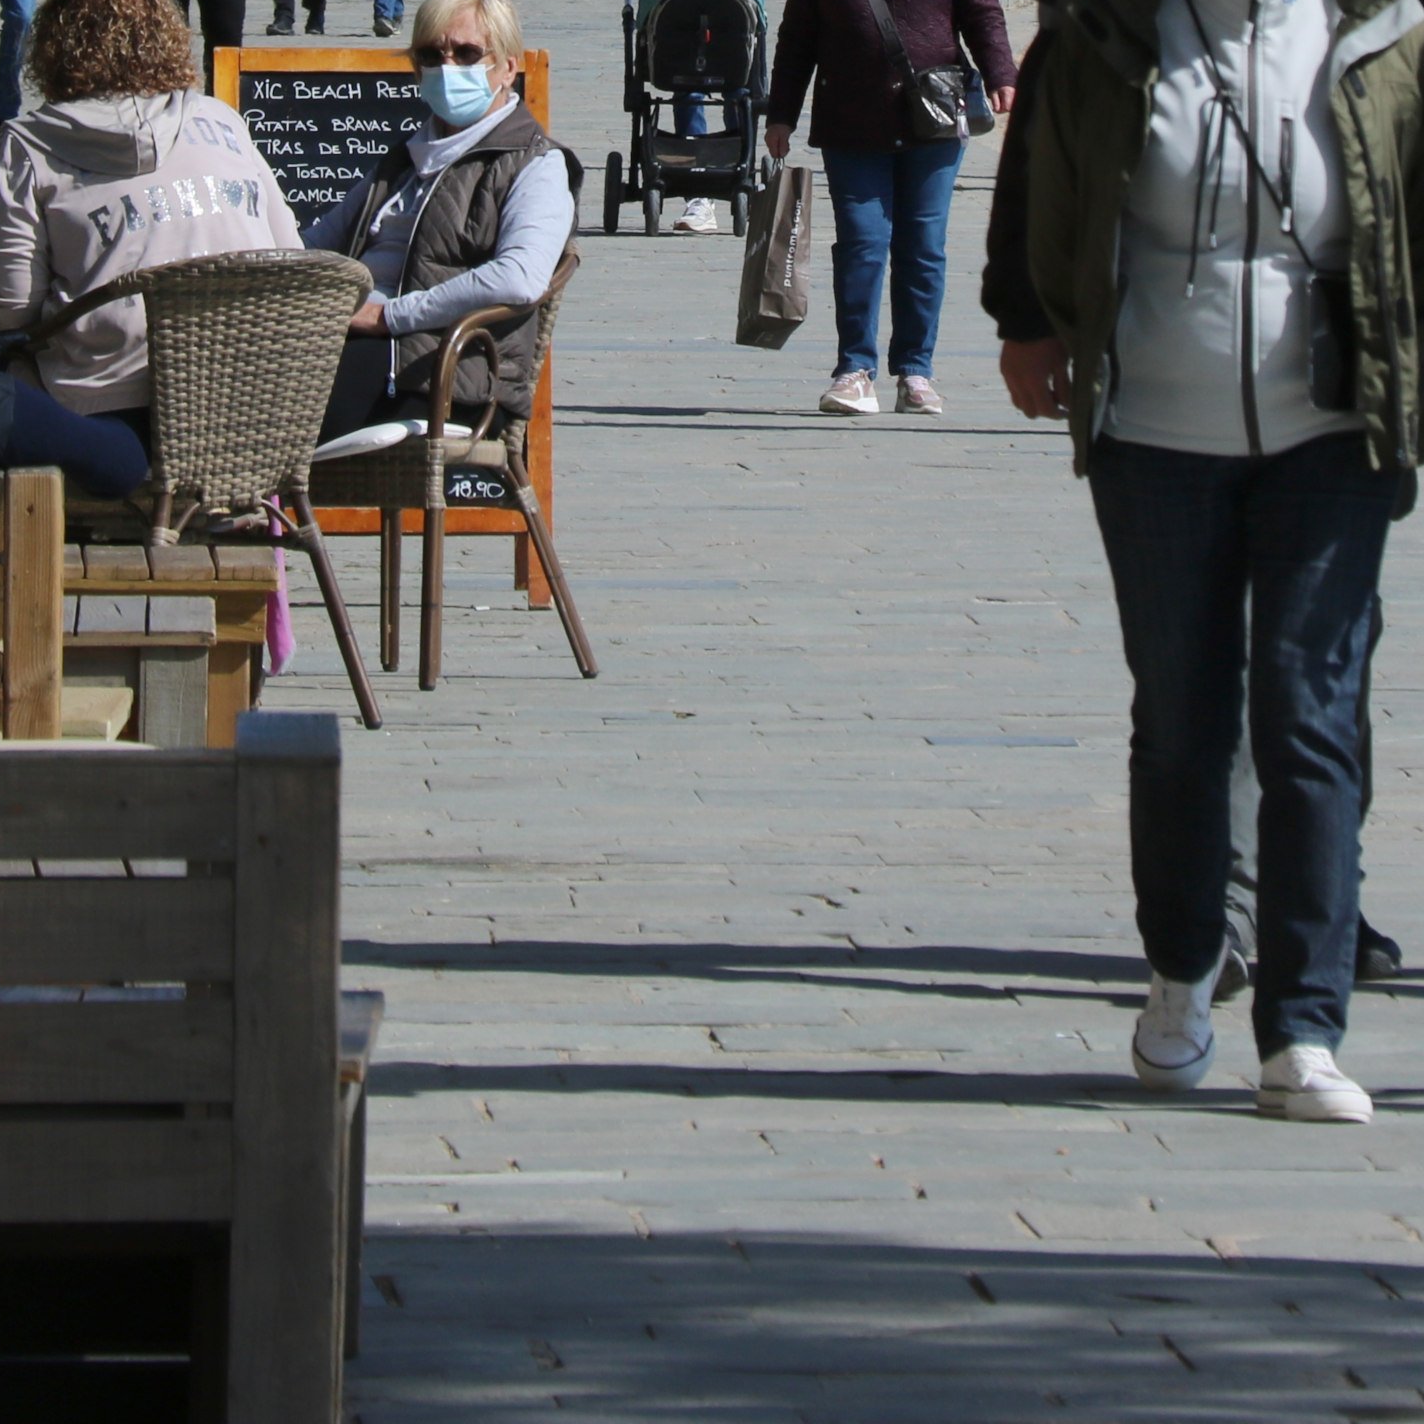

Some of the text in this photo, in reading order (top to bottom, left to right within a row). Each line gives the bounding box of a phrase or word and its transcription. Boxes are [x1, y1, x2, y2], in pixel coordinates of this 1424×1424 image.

[293, 81, 362, 100] BEACH
[244, 109, 319, 132] PATATAS
[331, 116, 392, 132] BRAVAS
[319, 142, 342, 155] DE
